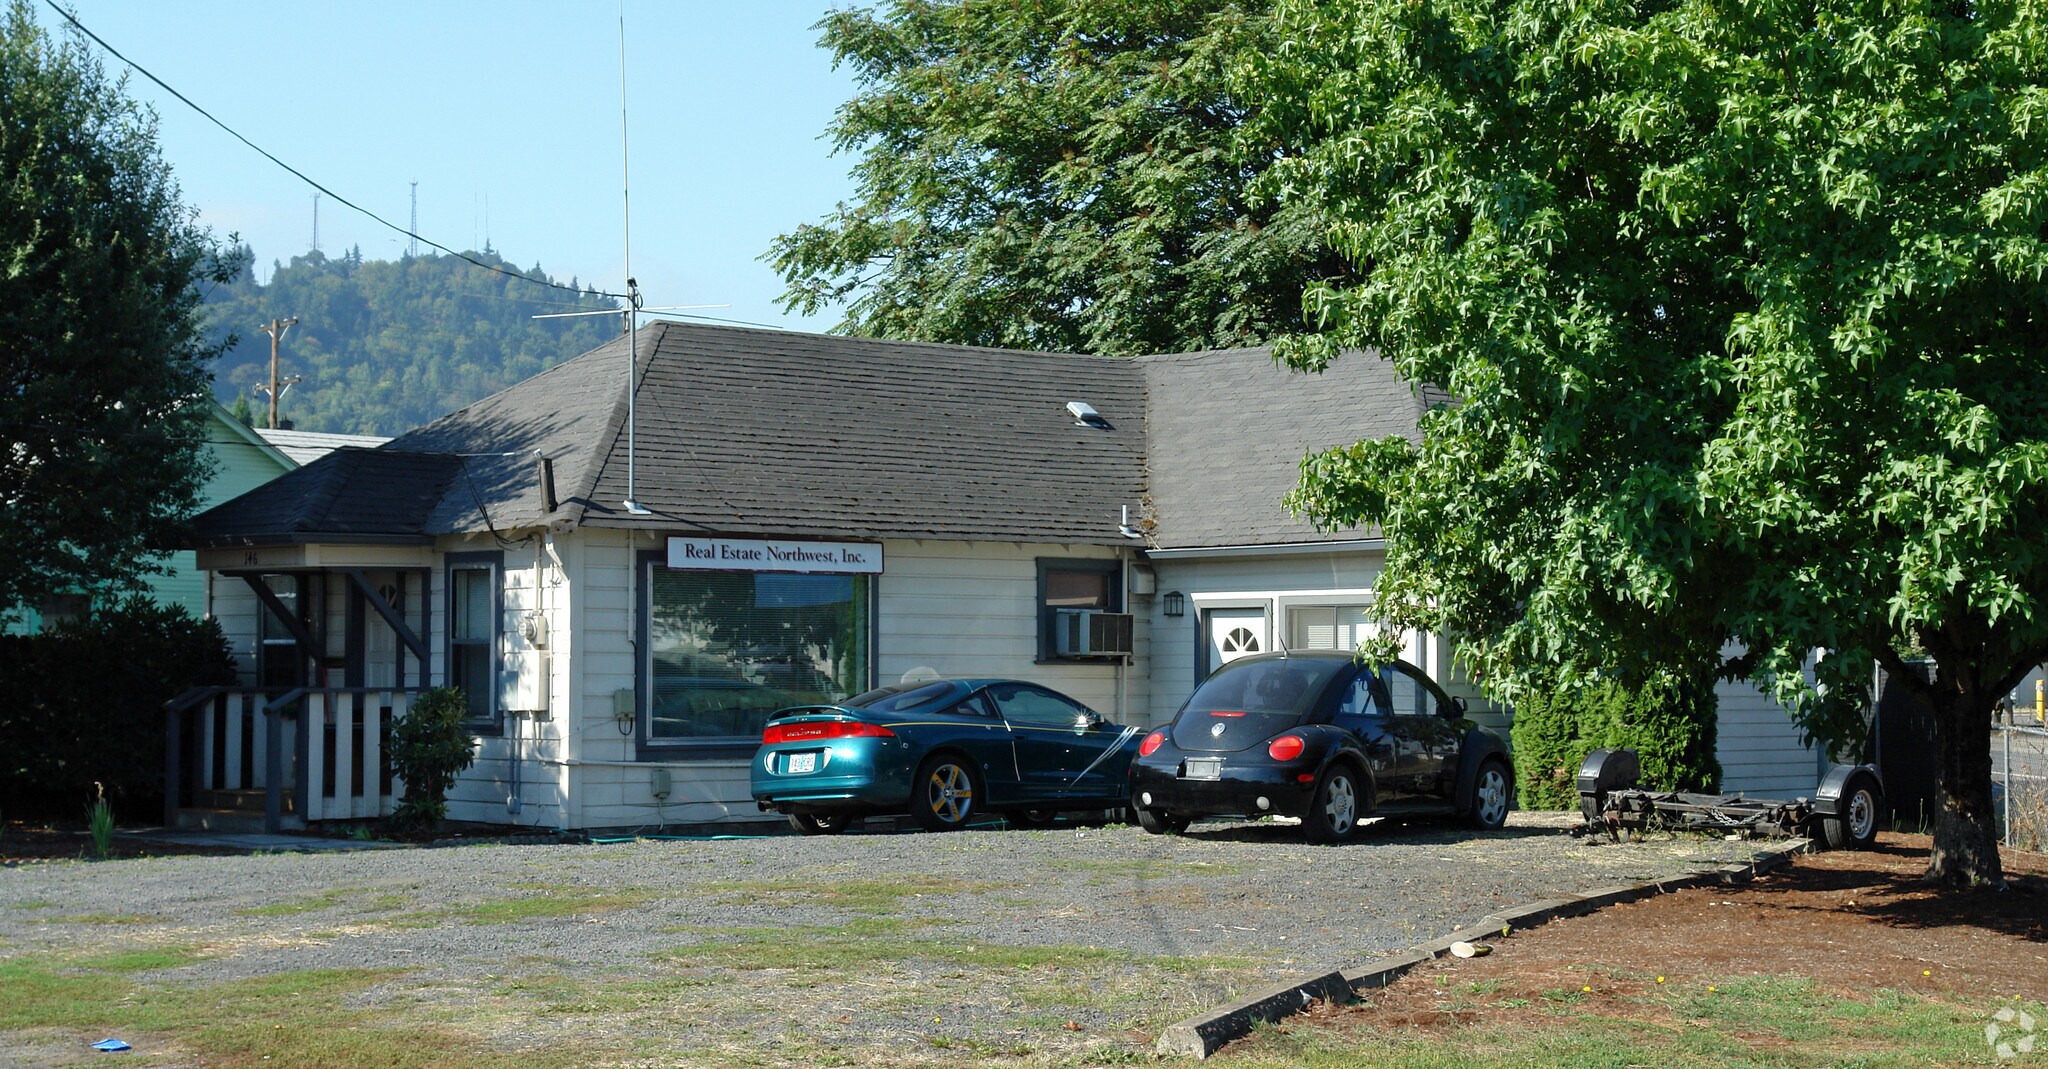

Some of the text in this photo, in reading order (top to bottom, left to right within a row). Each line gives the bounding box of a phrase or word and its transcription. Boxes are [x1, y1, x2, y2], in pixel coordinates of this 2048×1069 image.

[244, 551, 258, 565] 146
[685, 543, 866, 564] Real Estate Northwest, Inc.
